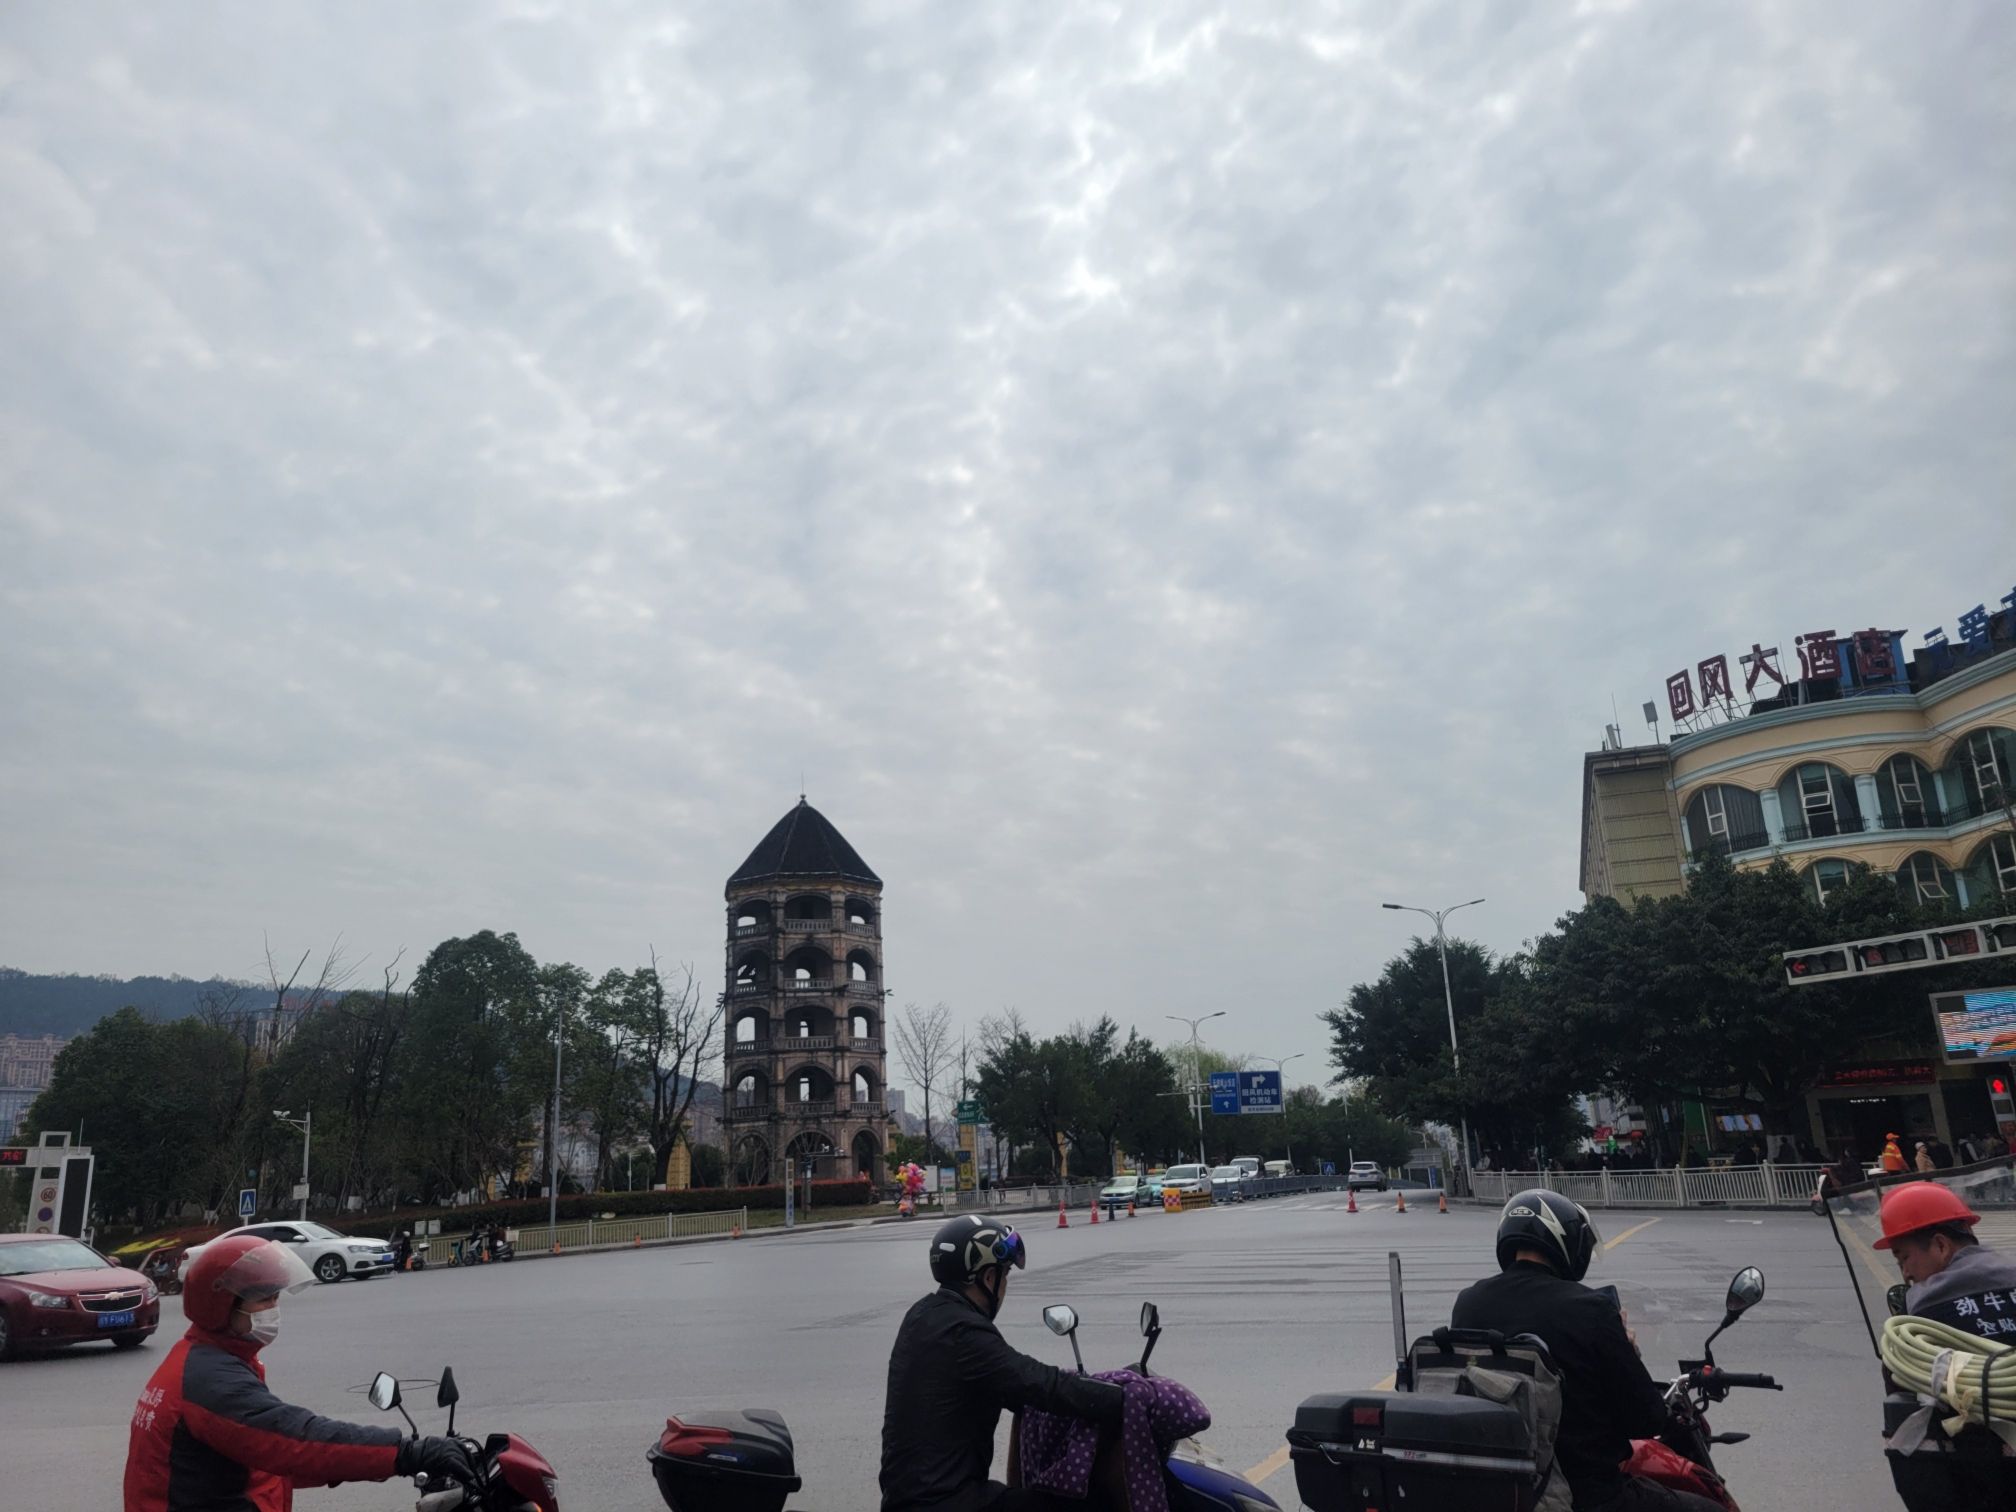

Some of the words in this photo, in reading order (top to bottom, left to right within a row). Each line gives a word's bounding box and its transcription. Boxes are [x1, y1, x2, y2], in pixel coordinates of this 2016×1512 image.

[1666, 627, 1896, 721] 回风大酒店
[43, 1191, 53, 1200] 60
